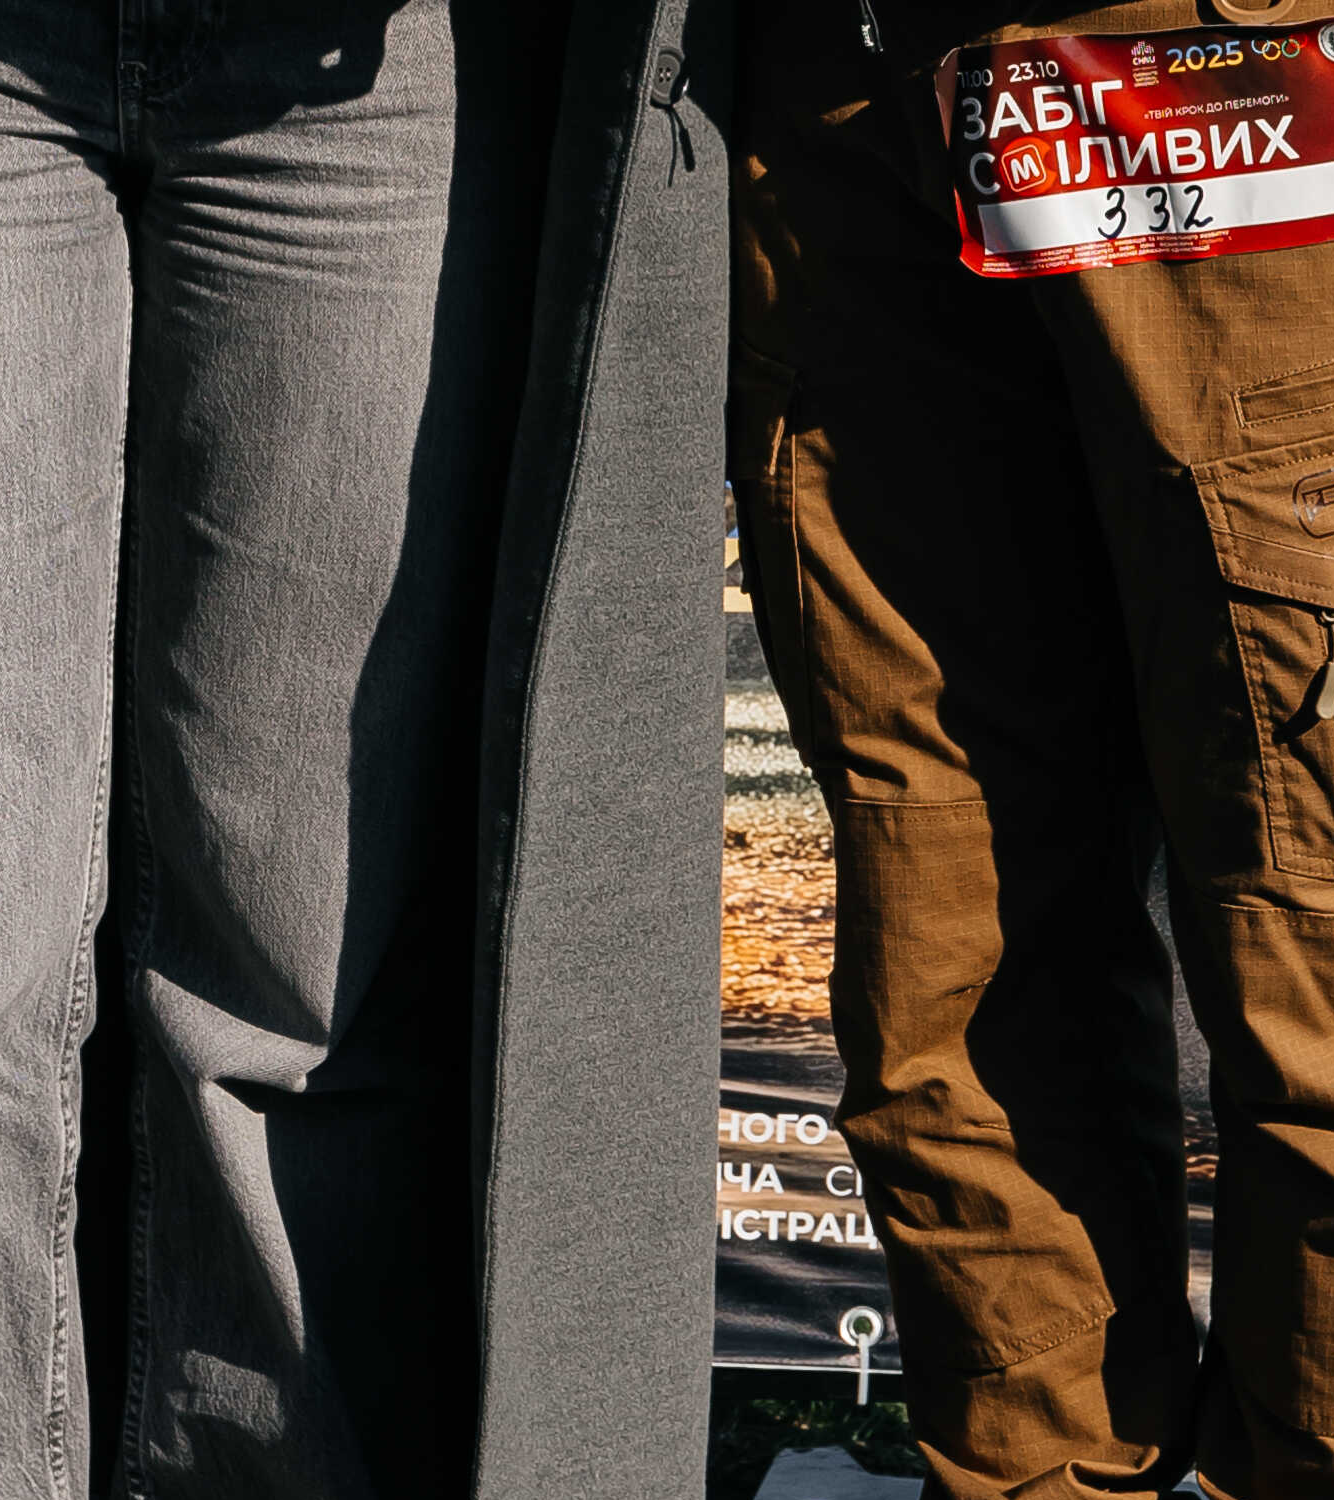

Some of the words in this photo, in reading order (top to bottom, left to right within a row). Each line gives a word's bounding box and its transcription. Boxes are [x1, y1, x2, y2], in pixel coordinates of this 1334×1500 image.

[1007, 60, 1059, 83] 23.10
[1167, 40, 1244, 74] 2025
[962, 80, 1123, 140] ЗАБІГ
[1175, 103, 1204, 117] КРОК
[1206, 101, 1223, 114] ДО
[717, 1161, 784, 1195] ЧА
